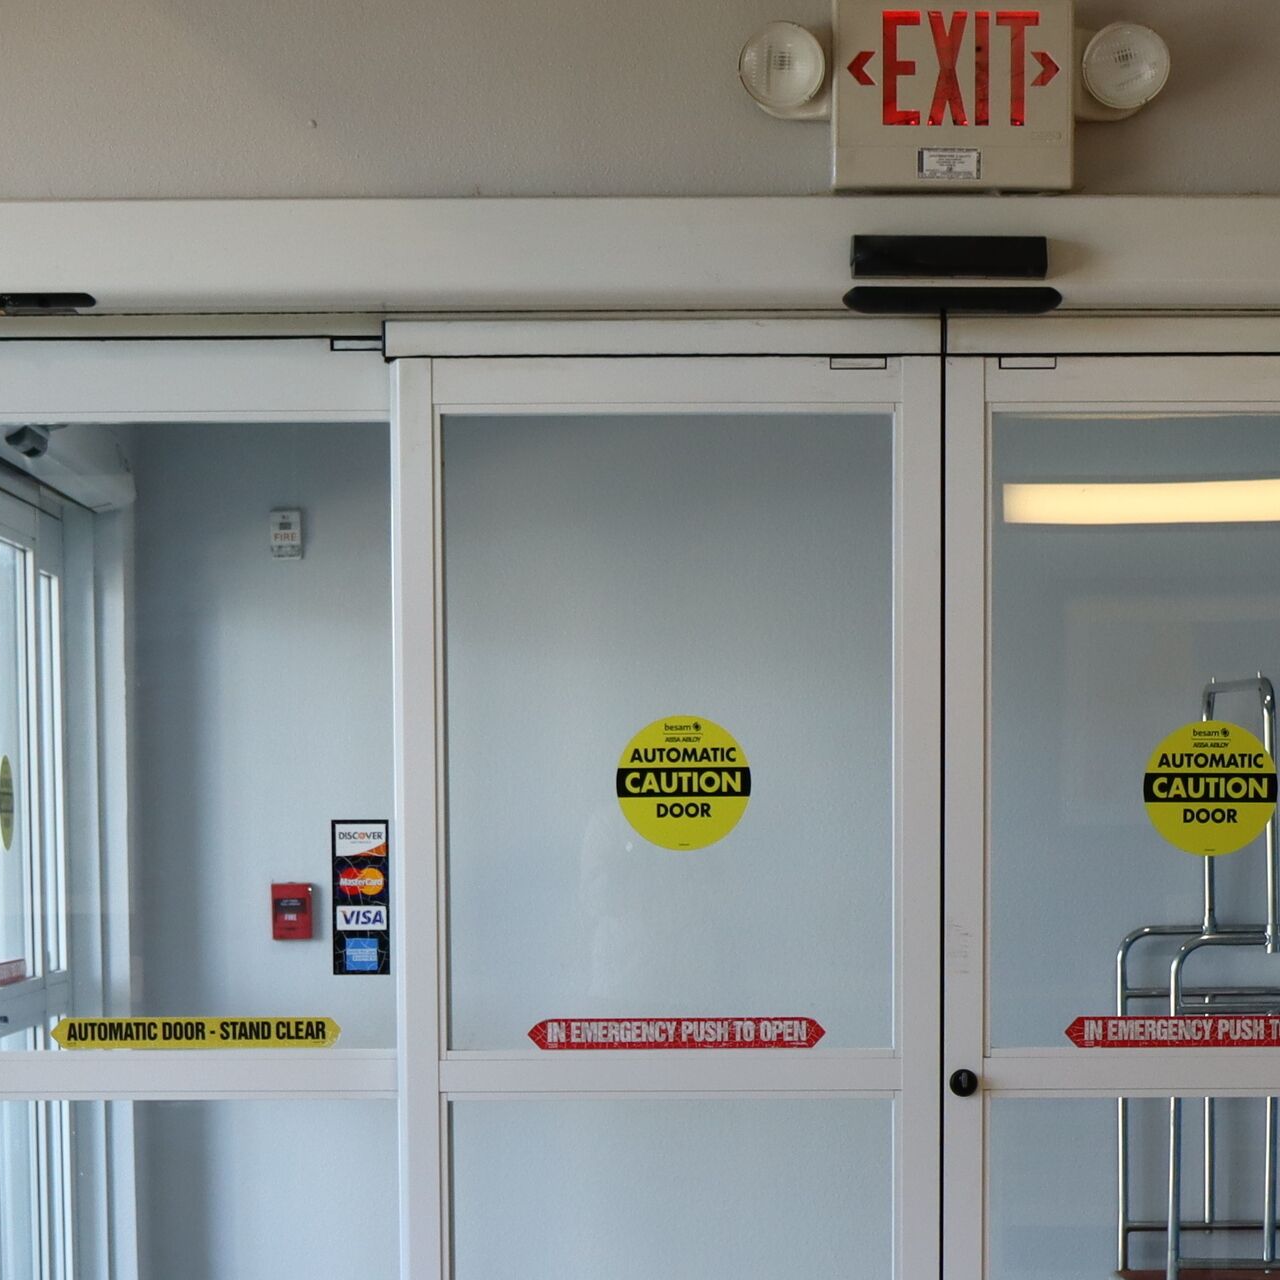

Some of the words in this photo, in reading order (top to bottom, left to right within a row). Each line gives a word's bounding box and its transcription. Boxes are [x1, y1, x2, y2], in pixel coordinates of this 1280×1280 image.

[882, 10, 1039, 126] EXIT
[273, 533, 297, 542] FIRE
[664, 723, 691, 731] besam
[1193, 728, 1219, 736] besam
[630, 747, 737, 763] AUTOMATIC
[1158, 753, 1264, 769] AUTOMATIC
[625, 771, 741, 793] CAUTION
[1152, 777, 1268, 799] CAUTION
[656, 803, 712, 818] DOOR
[1183, 808, 1238, 824] DOOR
[338, 831, 383, 840] DISCOVER
[339, 877, 384, 887] MasterCard
[341, 910, 384, 925] VISA
[67, 1021, 157, 1041] AUTOMATIC
[162, 1022, 206, 1041] DOOR
[220, 1021, 270, 1040] STAND
[275, 1021, 326, 1040] CLEAR
[546, 1021, 566, 1042] IN
[570, 1021, 675, 1042] EMERGENCY
[681, 1021, 727, 1042] PUSH
[732, 1021, 755, 1041] TO
[759, 1021, 807, 1041] OPEN
[1083, 1019, 1102, 1041] IN
[1107, 1019, 1213, 1041] EMERGENCY
[1218, 1019, 1264, 1040] PUSH
